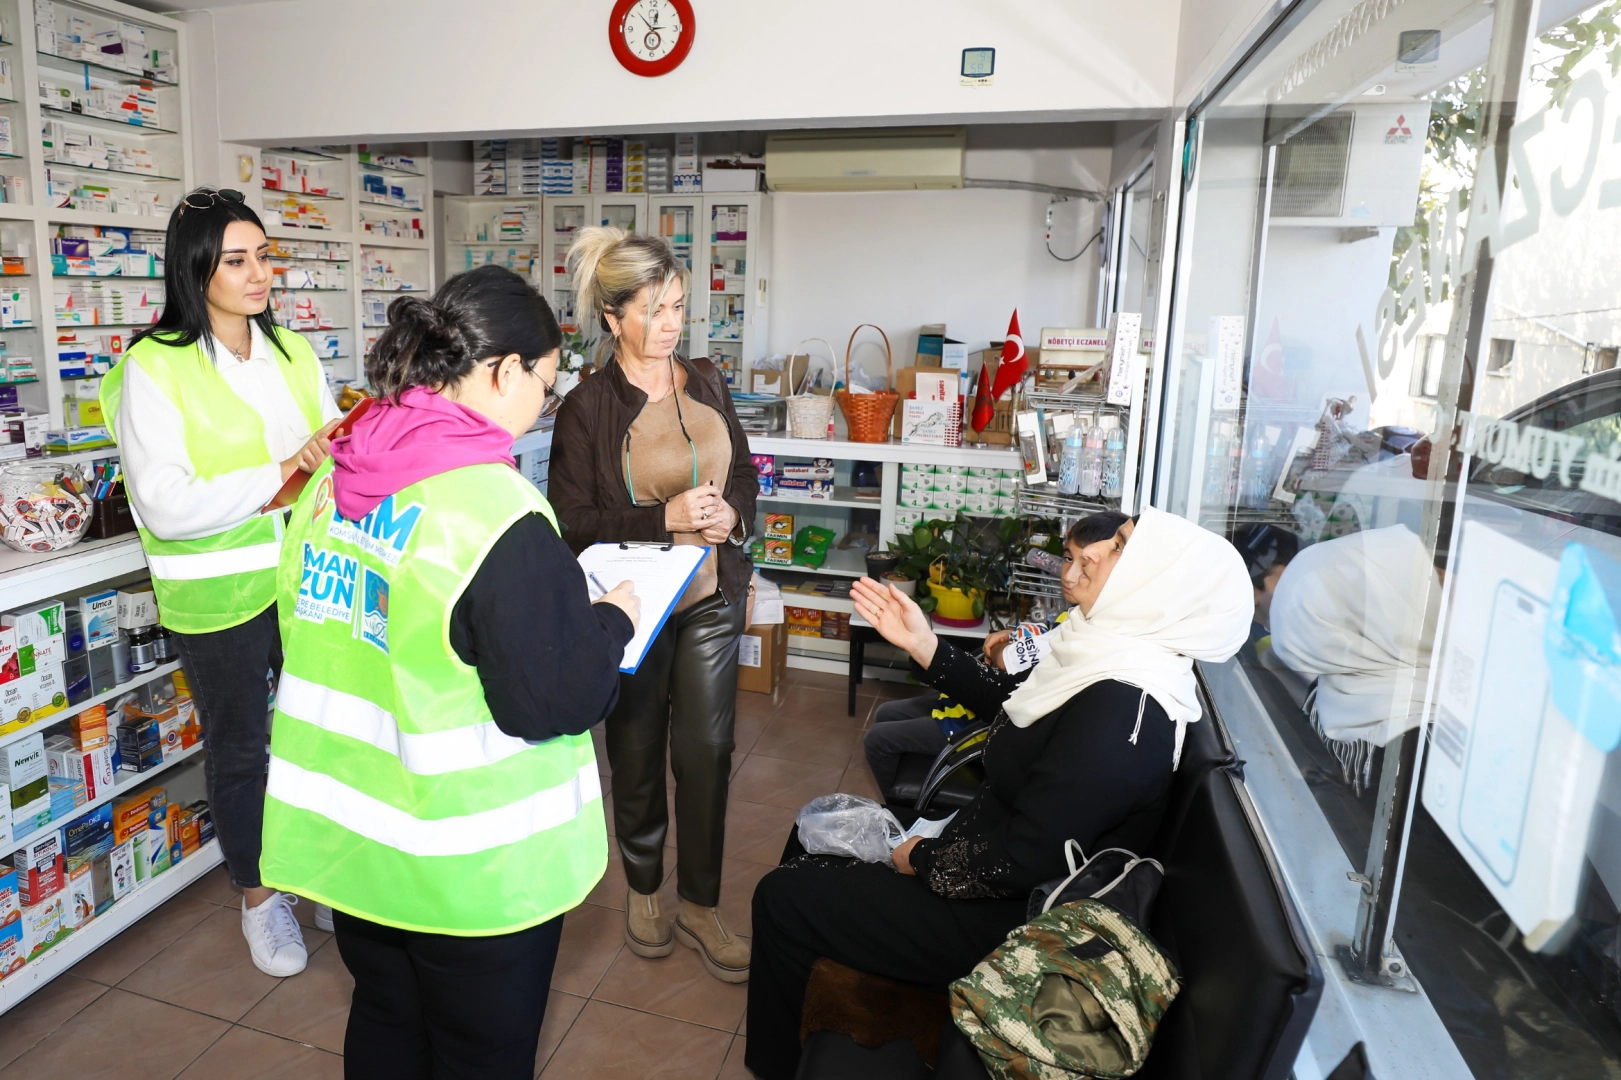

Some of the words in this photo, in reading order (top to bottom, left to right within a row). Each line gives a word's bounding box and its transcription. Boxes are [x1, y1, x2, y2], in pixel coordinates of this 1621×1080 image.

[1047, 338, 1075, 348] NÖBETÇİ
[92, 600, 112, 610] Umca
[310, 602, 350, 620] BELEDİYE
[14, 751, 40, 768] Newvit
[130, 803, 150, 815] Redoxon
[130, 820, 148, 832] Redoxon
